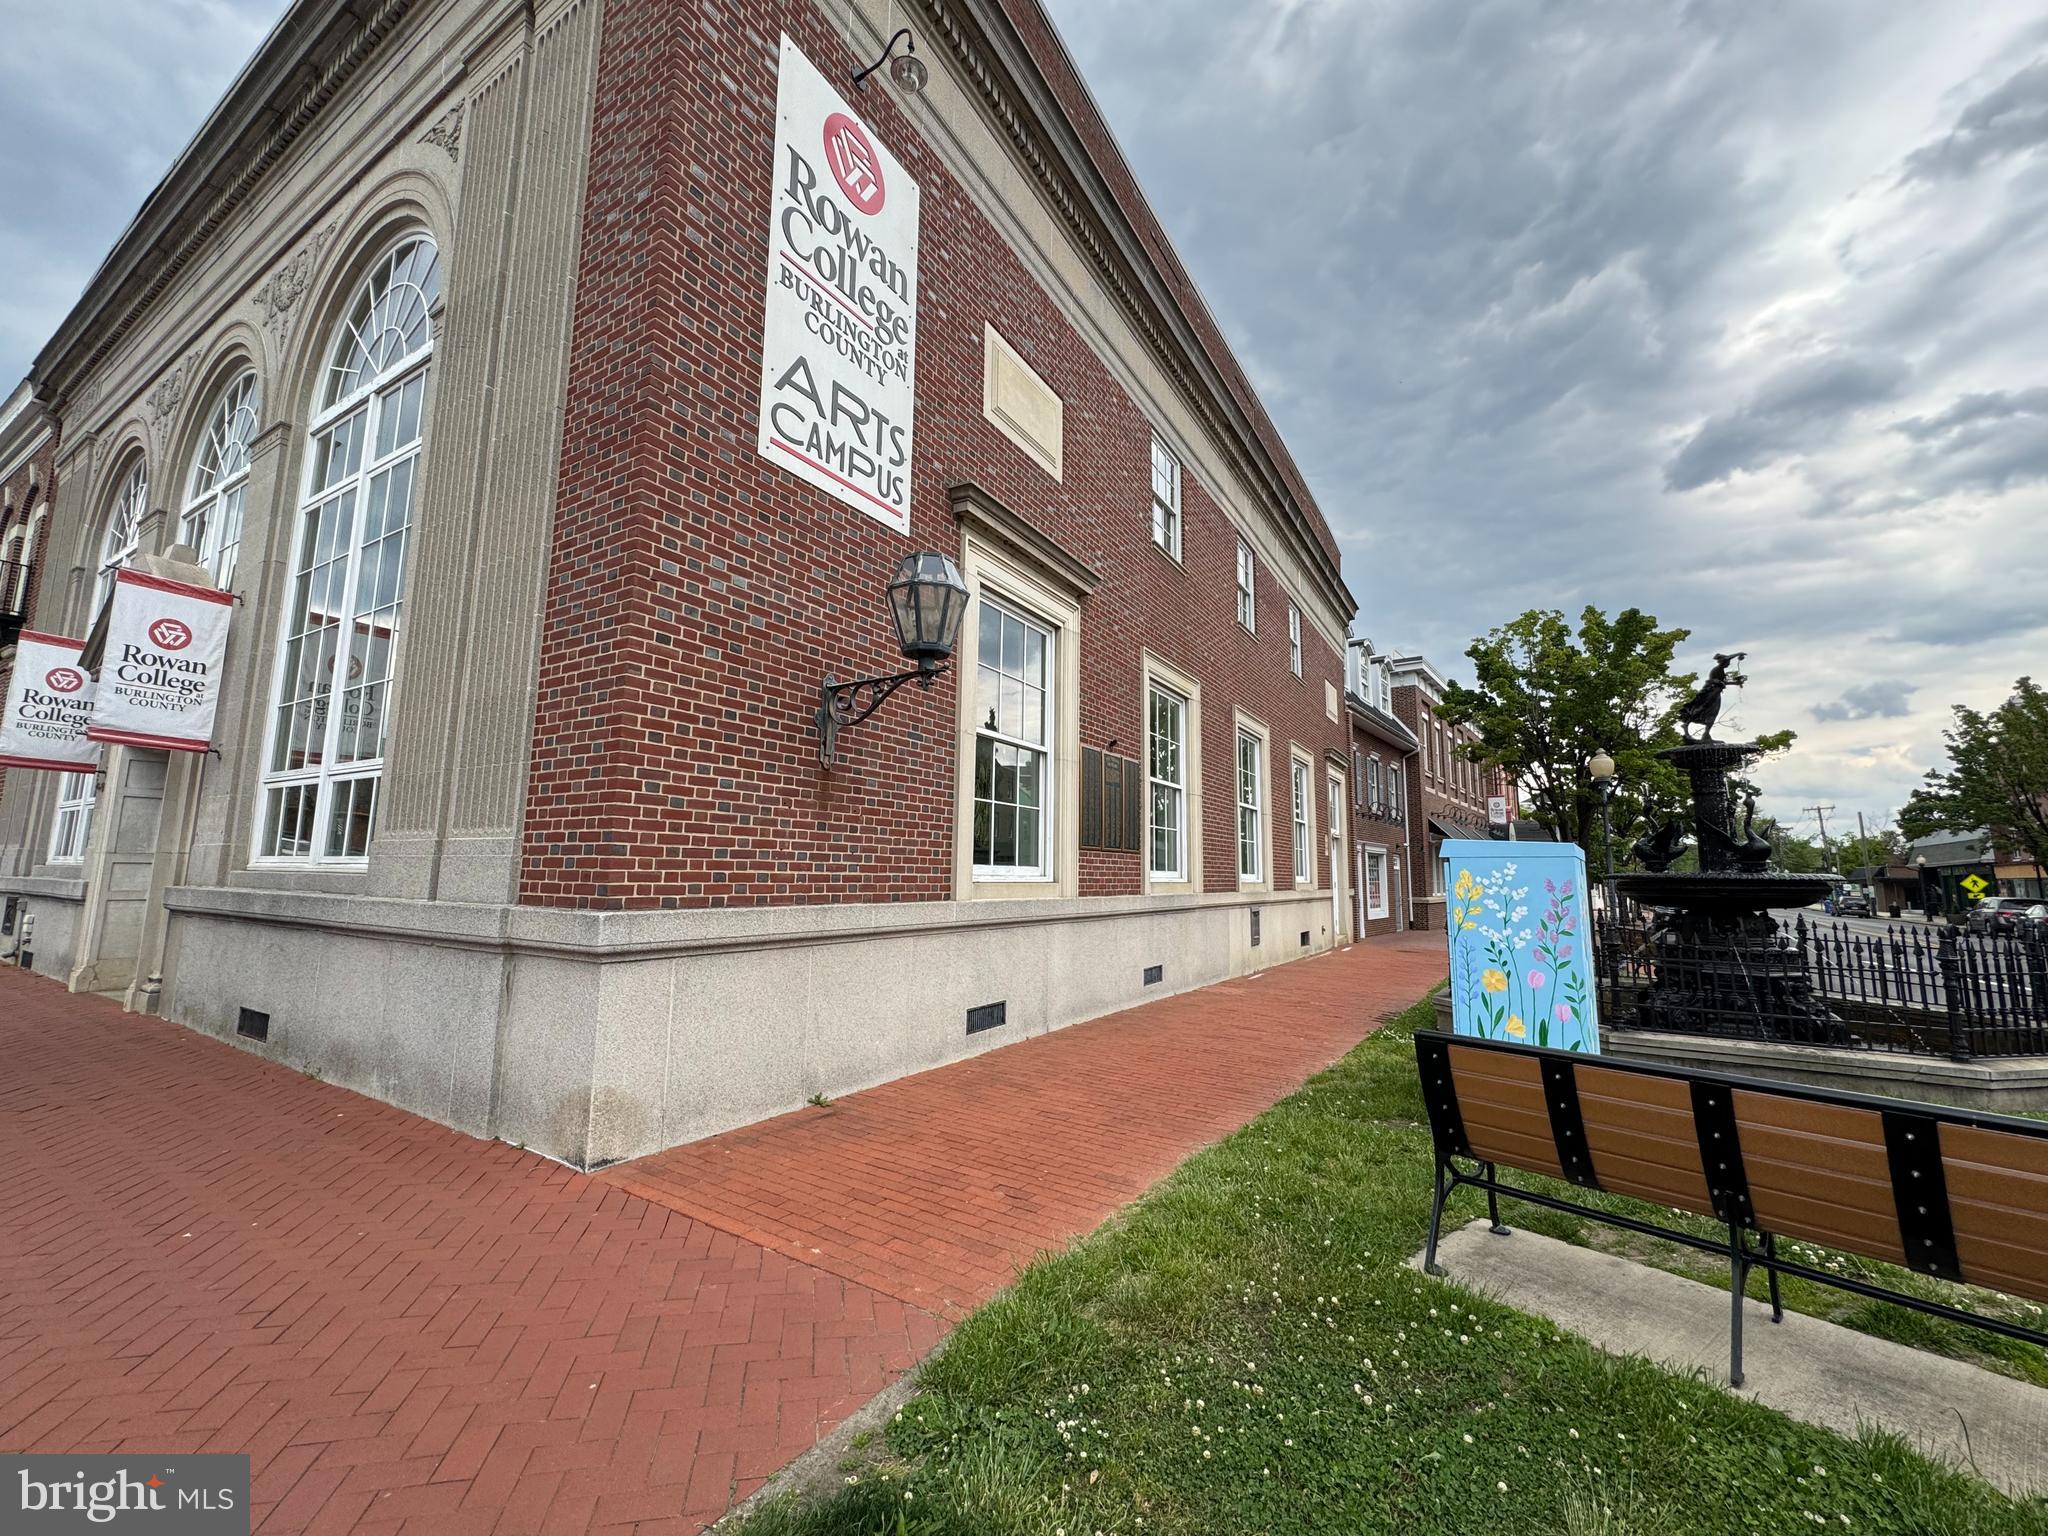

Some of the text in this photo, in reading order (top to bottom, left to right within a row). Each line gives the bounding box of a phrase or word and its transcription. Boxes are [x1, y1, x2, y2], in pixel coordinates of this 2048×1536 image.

[784, 143, 909, 305] Rowan
[781, 206, 909, 364] College at
[779, 263, 908, 382] BURLINGTON
[804, 311, 888, 387] COUNTY
[774, 355, 905, 467] ARTS
[770, 402, 904, 506] CAMPUS
[120, 643, 207, 675] Rowan
[114, 686, 203, 706] BURLINGTON
[117, 664, 206, 696] College
[21, 687, 95, 712] Rowan
[129, 697, 187, 712] COUNTY
[18, 704, 93, 728] College
[27, 730, 78, 742] COUNTY
